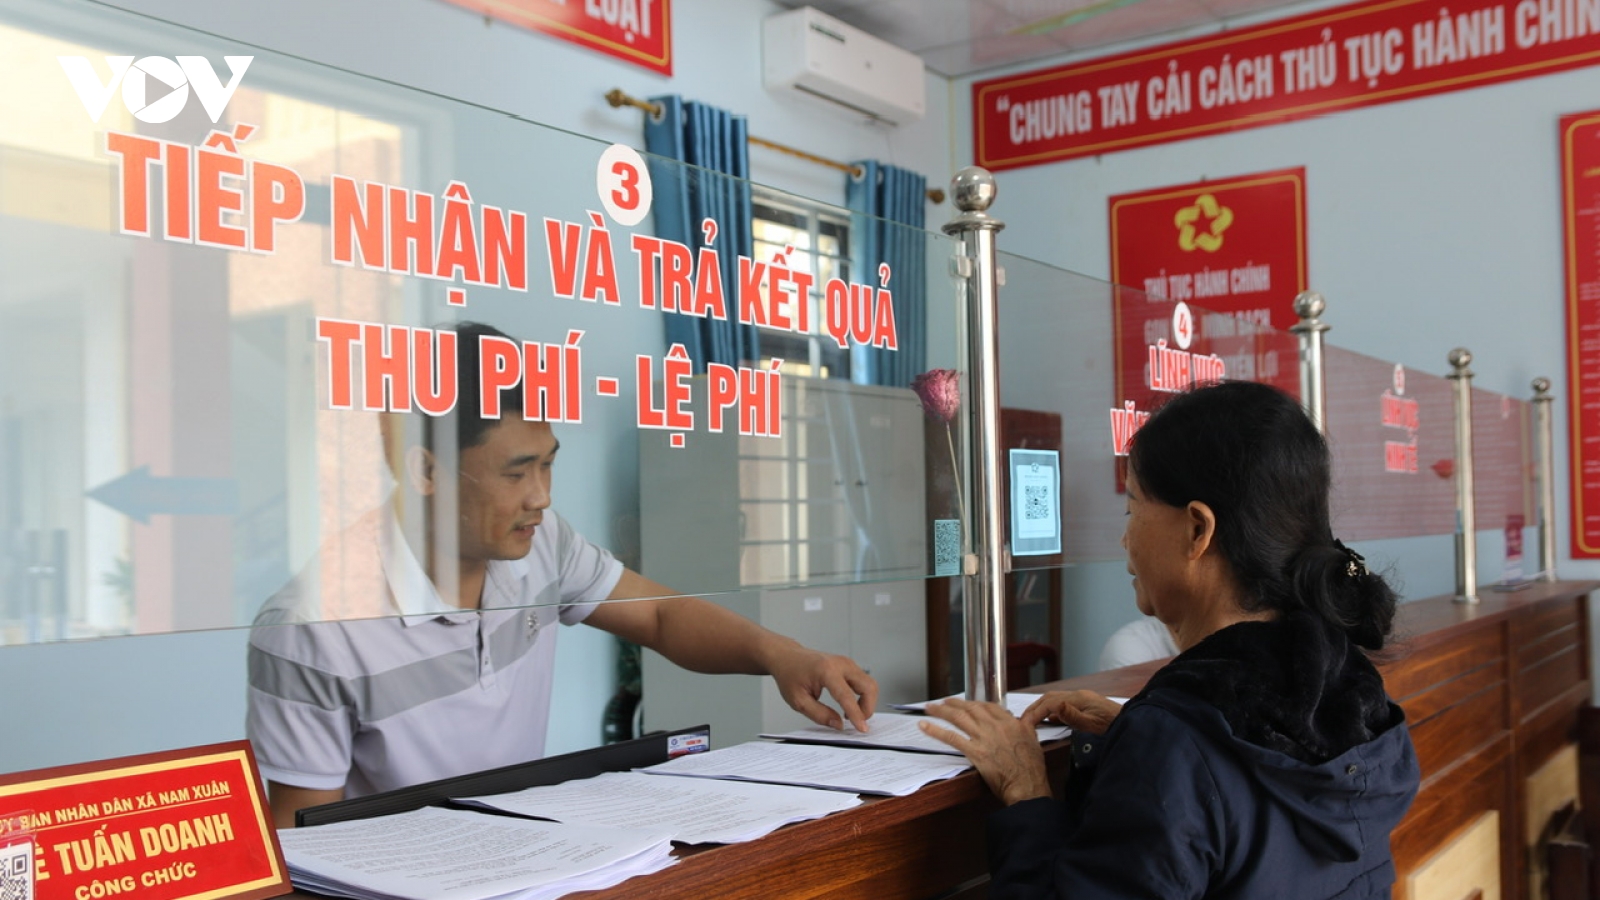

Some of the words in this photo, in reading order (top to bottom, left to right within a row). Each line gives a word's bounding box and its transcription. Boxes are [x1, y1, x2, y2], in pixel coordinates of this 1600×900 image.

[1098, 81, 1141, 129] TAY
[1147, 60, 1191, 120] CẢI
[1199, 54, 1274, 109] CÁCH
[1280, 27, 1337, 94] THỦ
[1344, 28, 1404, 89] TỤC
[1412, 7, 1505, 70] HÀNH
[610, 161, 640, 210] 3
[105, 121, 306, 255] TIẾP
[330, 174, 528, 307] NHẬN
[543, 210, 620, 306] VÀ
[631, 217, 727, 321] TRẢ
[737, 244, 813, 334] KẾT
[825, 262, 898, 350] QUẢ
[1178, 312, 1188, 339] 4
[316, 317, 458, 416] THU
[479, 329, 585, 423] PHÍ
[636, 343, 694, 448] LỆ
[707, 358, 784, 438] PHÍ
[1149, 338, 1190, 392] LĨNH
[19, 811, 52, 830] BAN
[55, 803, 99, 823] NHÂN
[102, 797, 134, 815] DÂN
[135, 791, 157, 809] XÃ
[159, 787, 190, 805] NAM
[192, 780, 230, 799] XUÂN
[54, 823, 137, 875] TUẤN
[139, 812, 235, 858] DOANH
[75, 876, 136, 900] CÔNG
[141, 861, 197, 887] CHỨC
